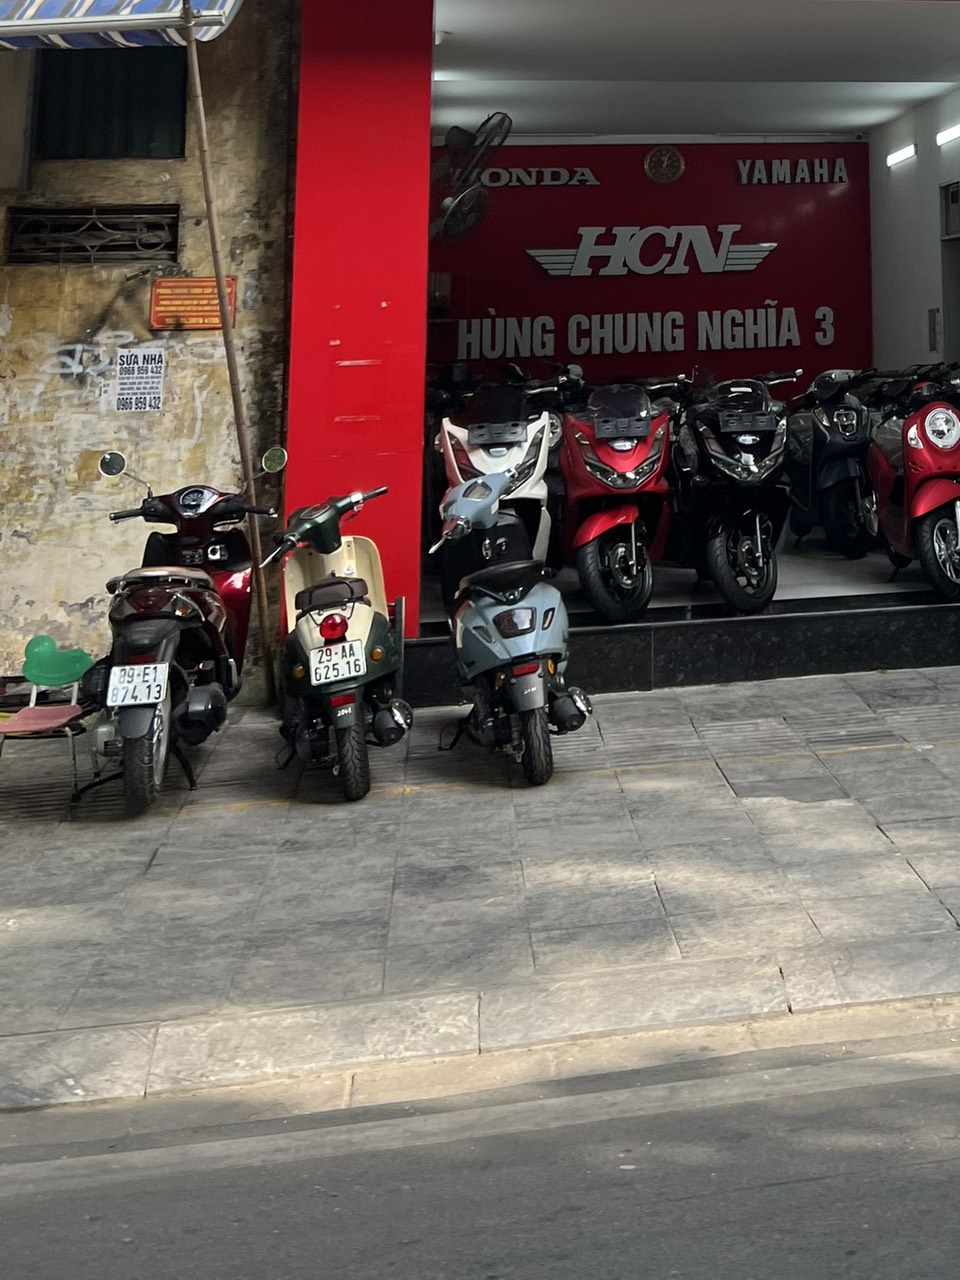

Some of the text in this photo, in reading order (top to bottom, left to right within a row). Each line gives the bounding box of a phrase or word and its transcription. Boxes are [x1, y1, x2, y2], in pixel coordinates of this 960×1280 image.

[736, 157, 848, 185] YAMAHA
[569, 223, 743, 277] HCN
[457, 299, 835, 360] HÙNG CHUNG NGHĨA 3
[317, 648, 356, 665] 29-AA
[314, 660, 361, 683] 625.16
